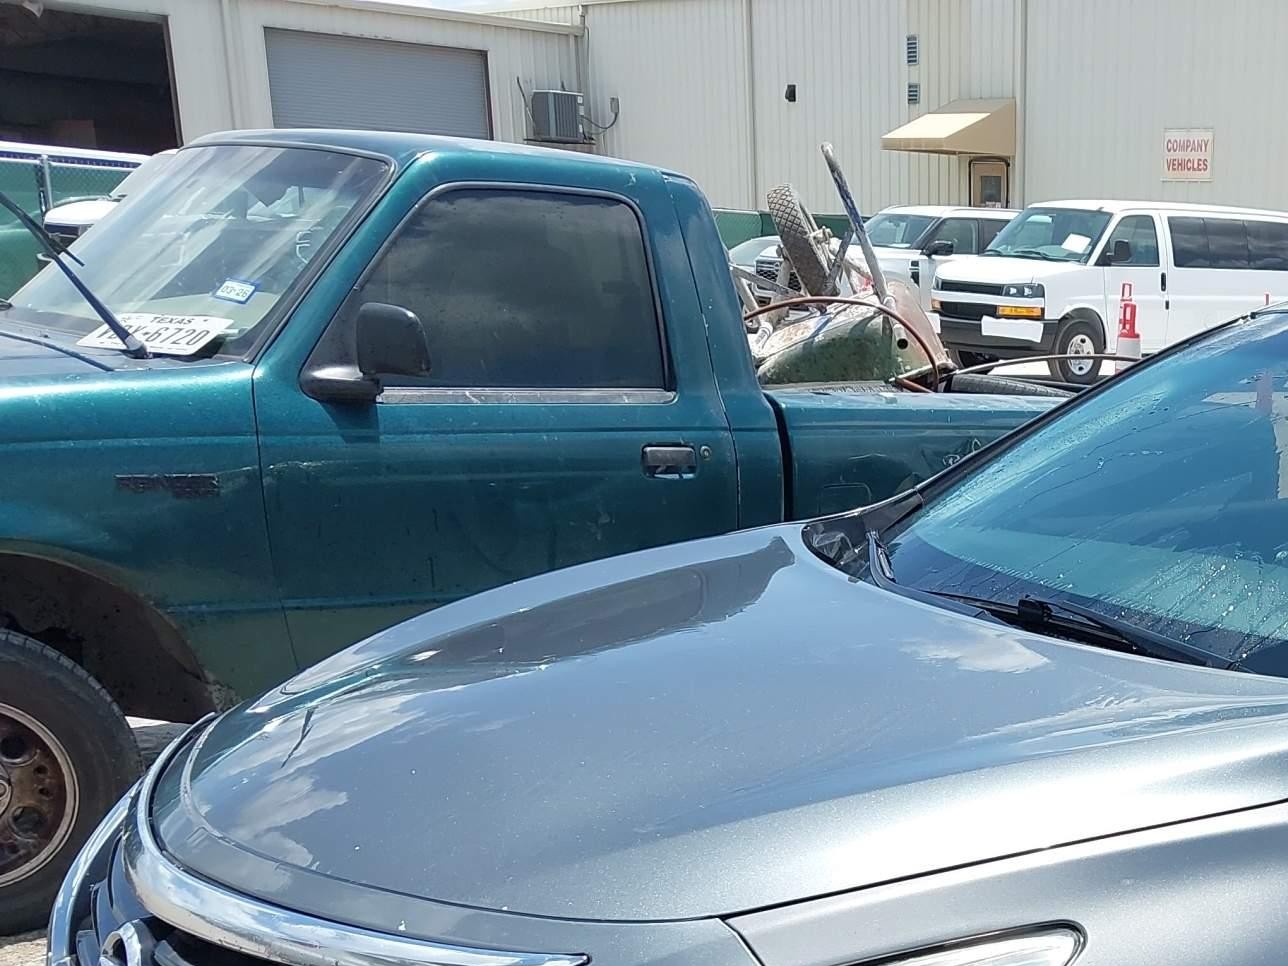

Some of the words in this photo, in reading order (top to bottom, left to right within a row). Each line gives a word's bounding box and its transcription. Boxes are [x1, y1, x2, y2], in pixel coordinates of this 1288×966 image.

[1166, 139, 1209, 153] COMPANY
[1166, 158, 1208, 172] VEHICLES
[149, 316, 194, 325] TEXAS
